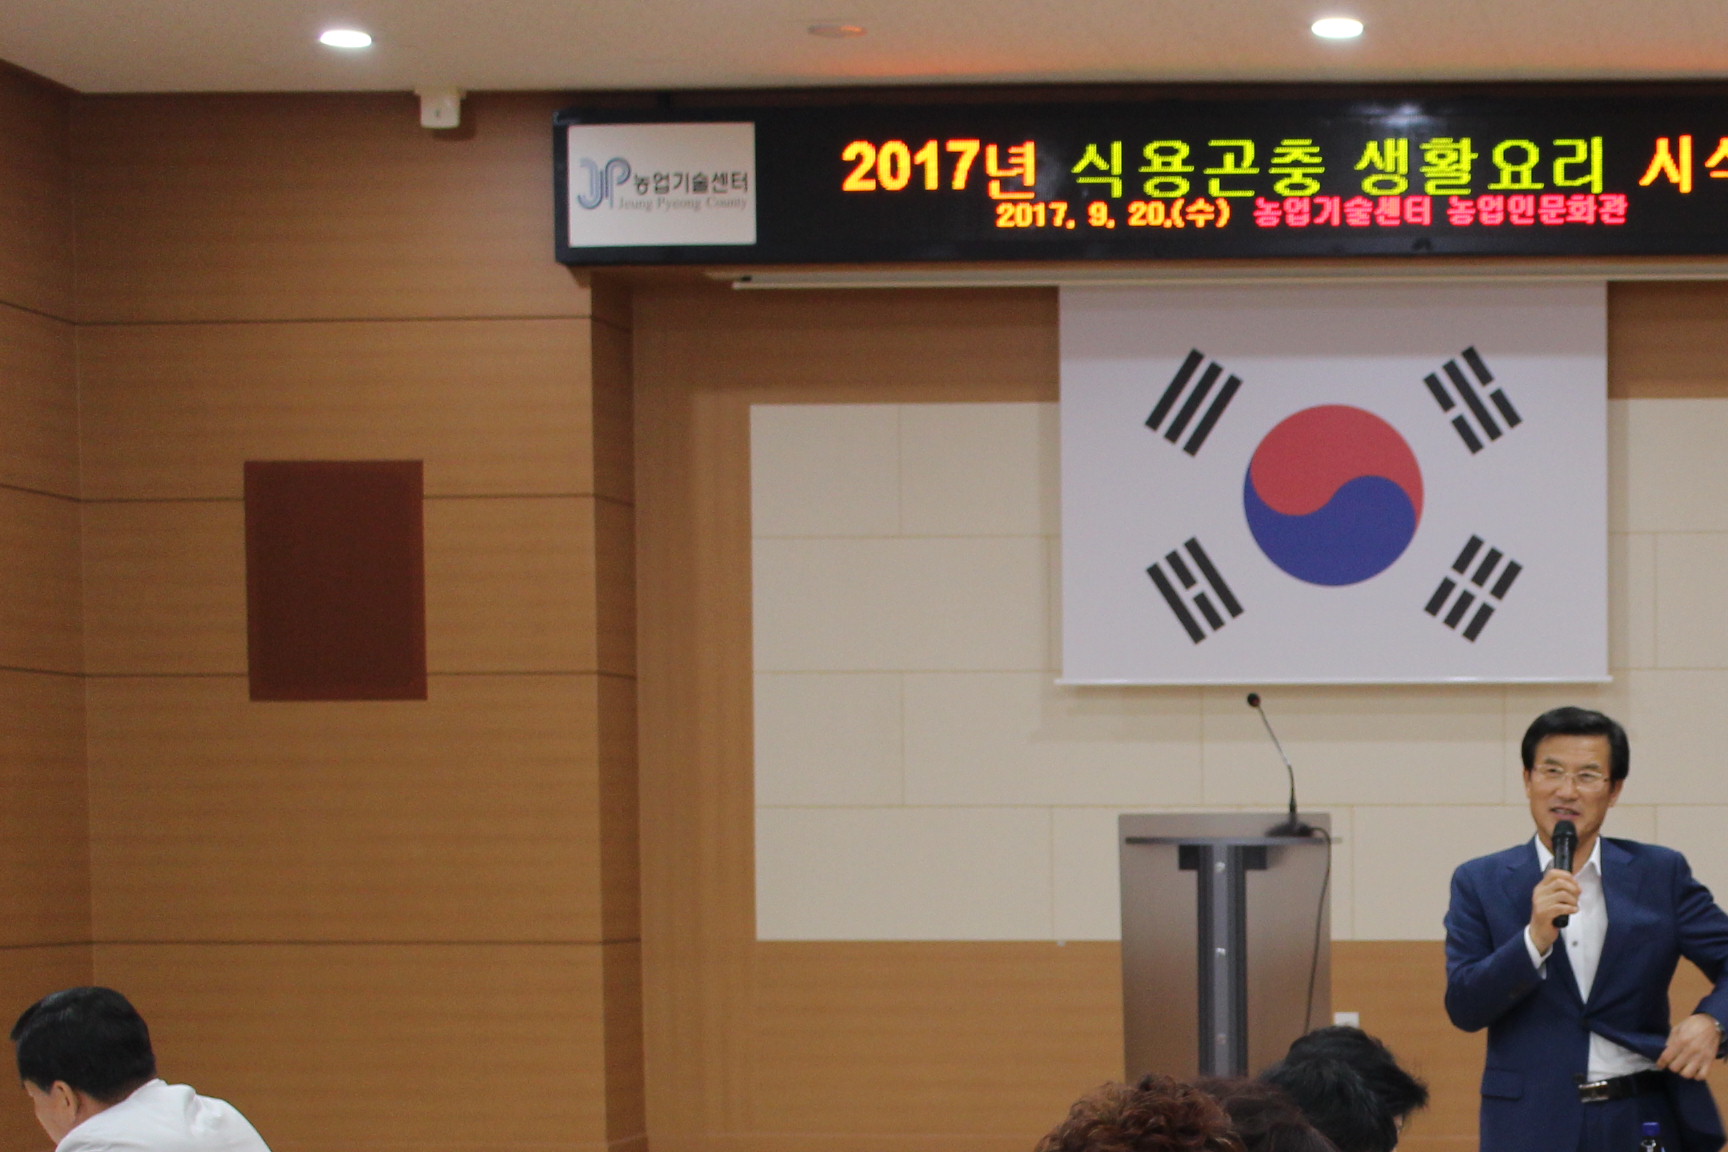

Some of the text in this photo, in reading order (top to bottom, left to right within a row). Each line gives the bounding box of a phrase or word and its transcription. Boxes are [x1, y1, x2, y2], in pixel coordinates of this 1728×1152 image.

[634, 171, 748, 195] 농업기술센터
[842, 139, 1036, 199] 2017년
[1071, 138, 1325, 198] 식용곤충
[1353, 136, 1603, 196] 생활요리
[1253, 195, 1432, 227] 농업기술센터
[1447, 194, 1628, 226] 농업인문화관
